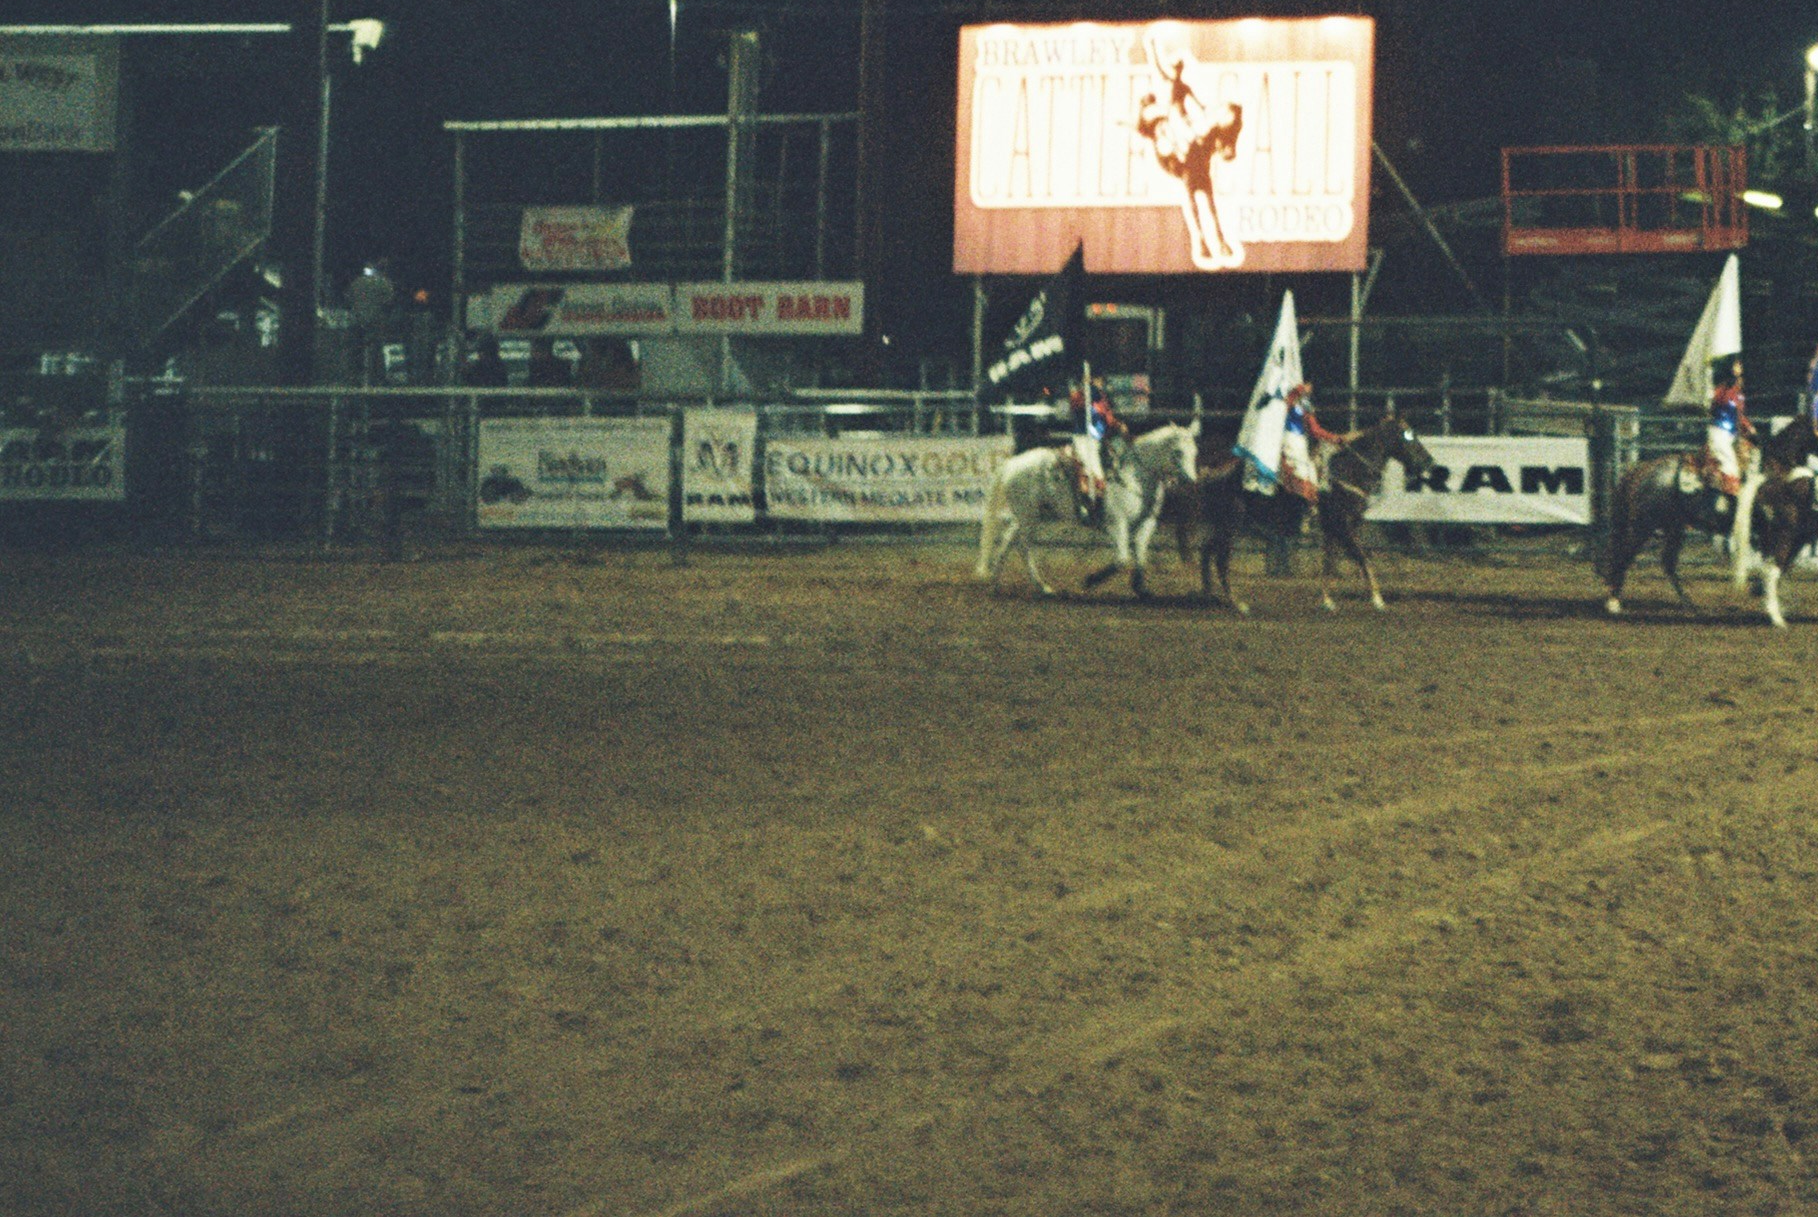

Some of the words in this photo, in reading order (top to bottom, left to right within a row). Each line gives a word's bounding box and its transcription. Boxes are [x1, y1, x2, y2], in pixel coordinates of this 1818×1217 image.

[982, 38, 1126, 67] BRAWLEY
[976, 72, 1152, 200] CATTLE
[1215, 70, 1346, 197] CALL
[1238, 203, 1346, 235] RODEO
[692, 295, 762, 320] BOOT
[777, 294, 850, 320] BARN
[1405, 465, 1584, 495] RAM
